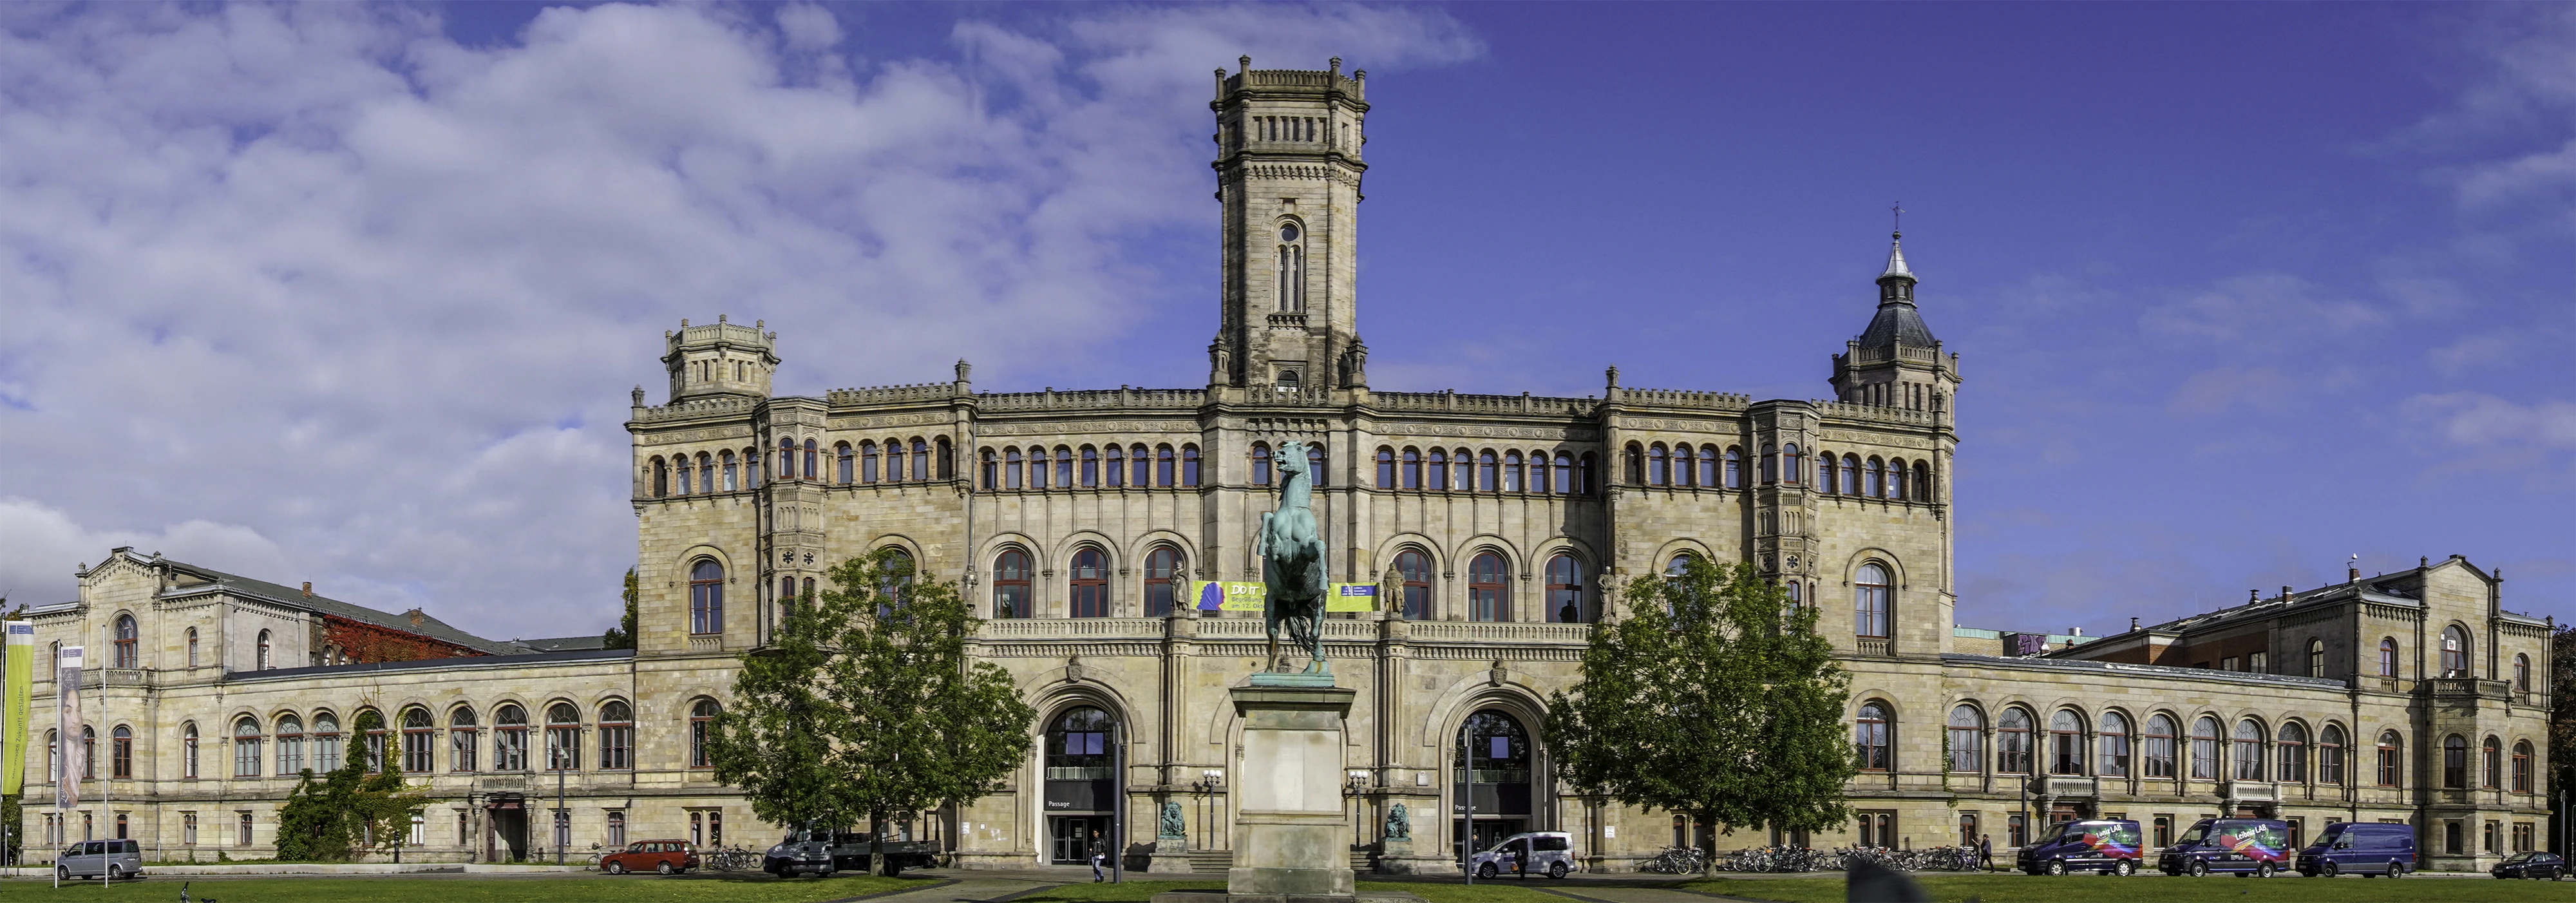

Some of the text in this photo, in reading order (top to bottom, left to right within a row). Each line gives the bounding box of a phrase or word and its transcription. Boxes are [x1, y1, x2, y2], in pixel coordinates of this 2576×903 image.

[1231, 585, 1247, 594] DO
[1249, 586, 1260, 595] IT
[2110, 824, 2122, 833] LAB
[2235, 824, 2267, 841] Leibniz LAB
